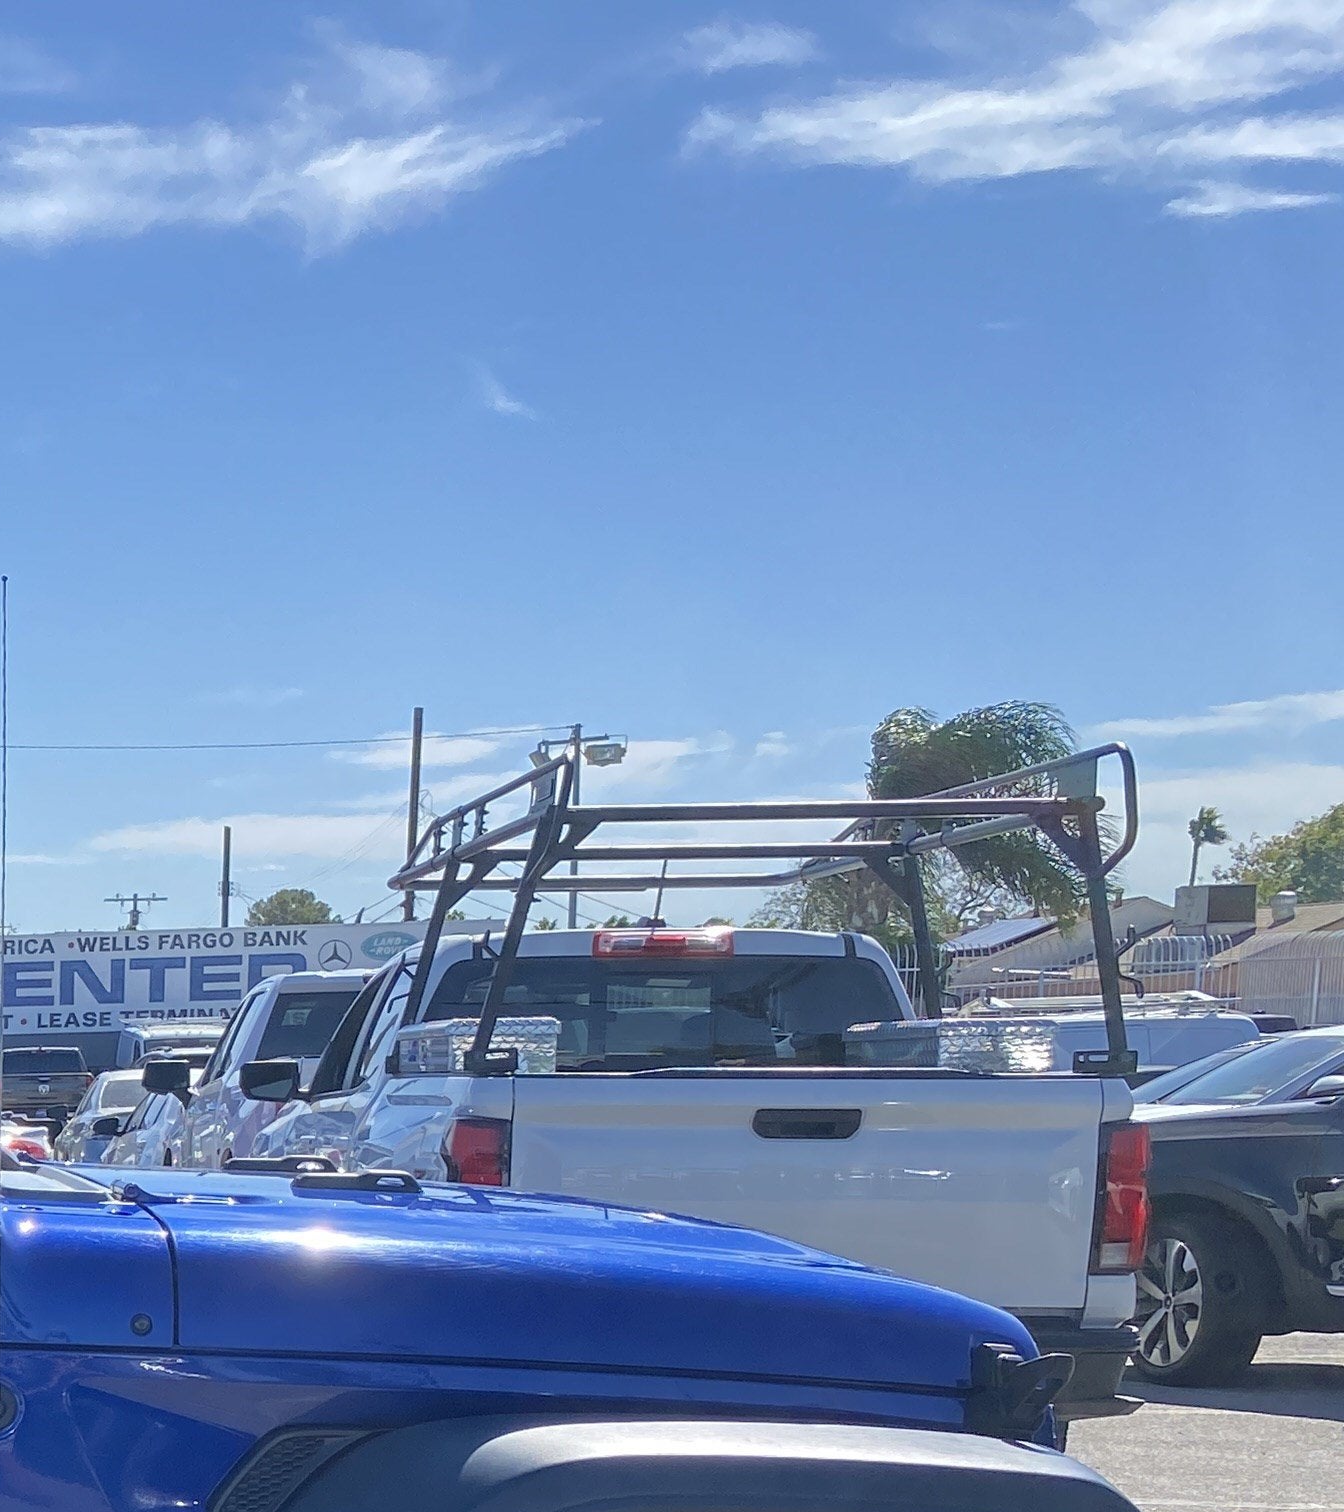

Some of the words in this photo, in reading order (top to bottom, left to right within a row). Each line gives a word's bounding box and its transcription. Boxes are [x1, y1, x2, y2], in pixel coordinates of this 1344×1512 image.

[76, 934, 150, 953] WELLS
[157, 931, 234, 950] FARGO
[243, 930, 308, 947] BANK
[36, 1011, 112, 1029] LEASE
[119, 1007, 237, 1020] TERMINA
